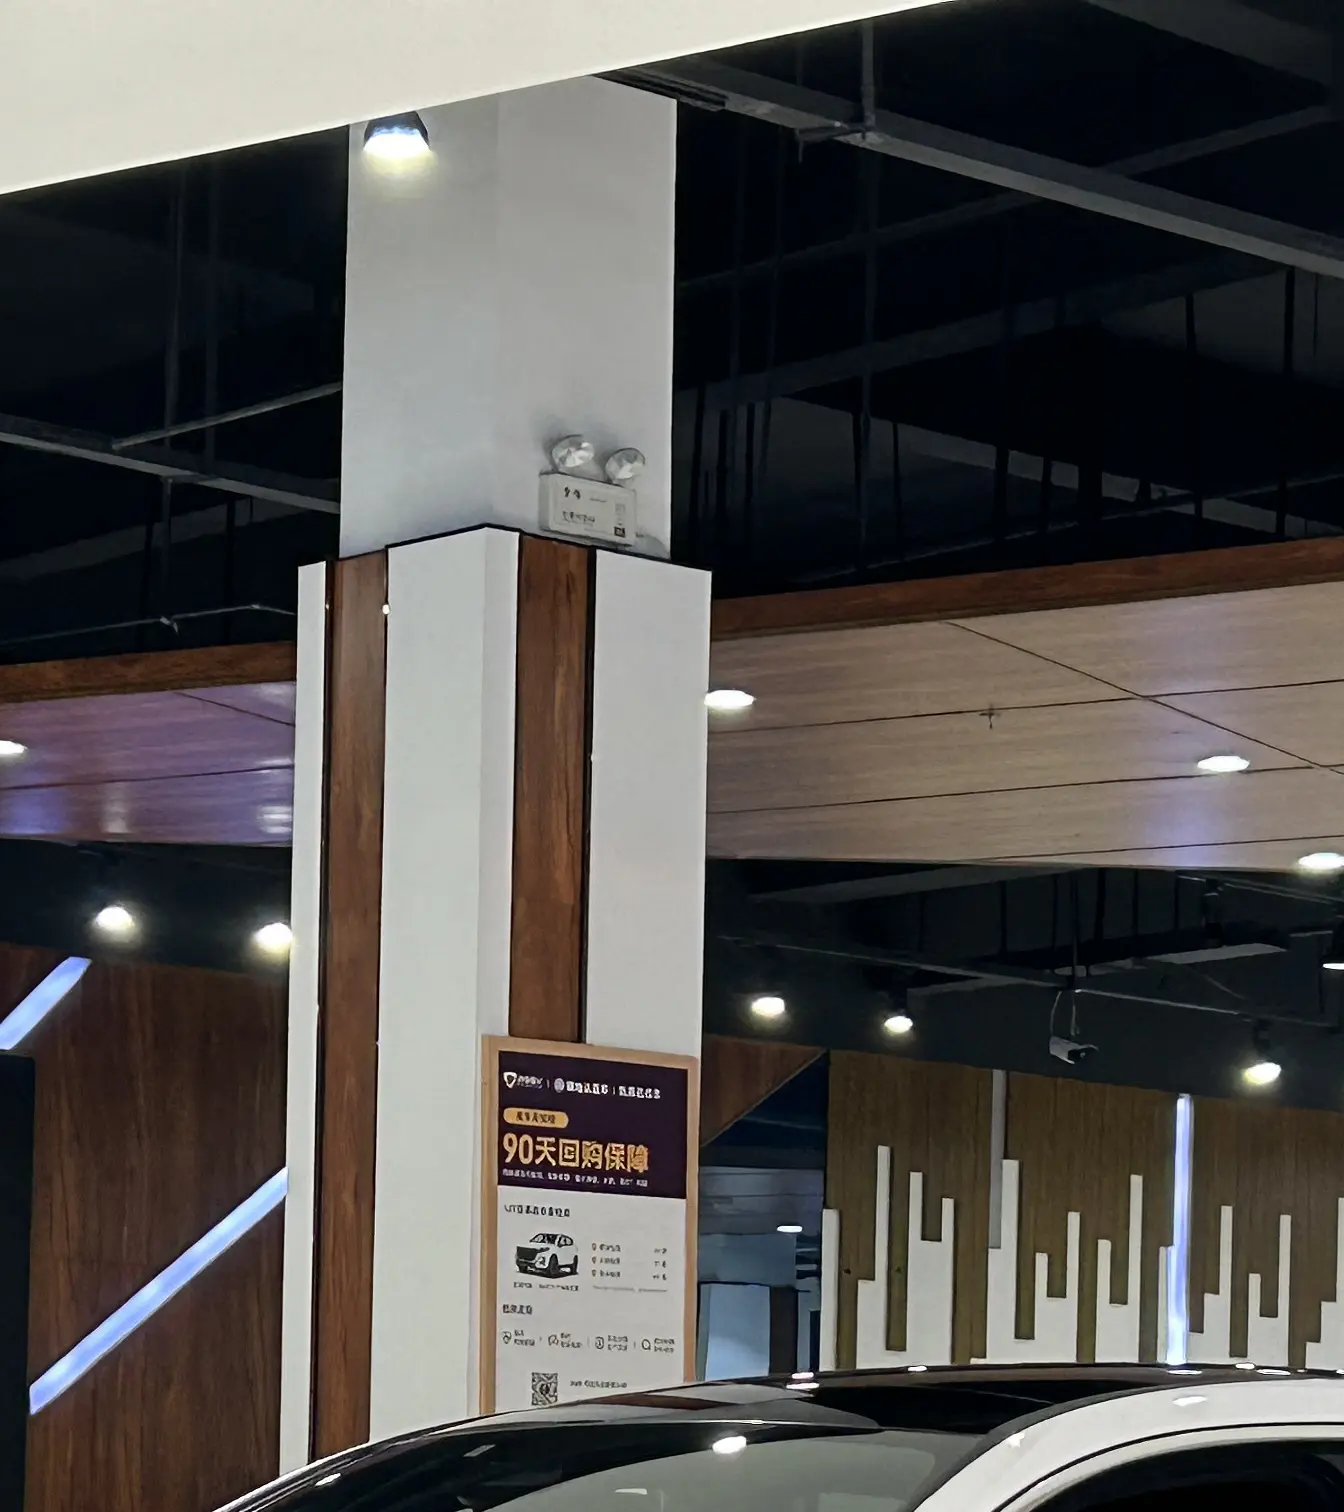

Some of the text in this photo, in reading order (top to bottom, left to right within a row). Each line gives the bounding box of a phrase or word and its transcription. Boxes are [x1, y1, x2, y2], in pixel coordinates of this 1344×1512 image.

[503, 1132, 649, 1173] 90天回购保障
